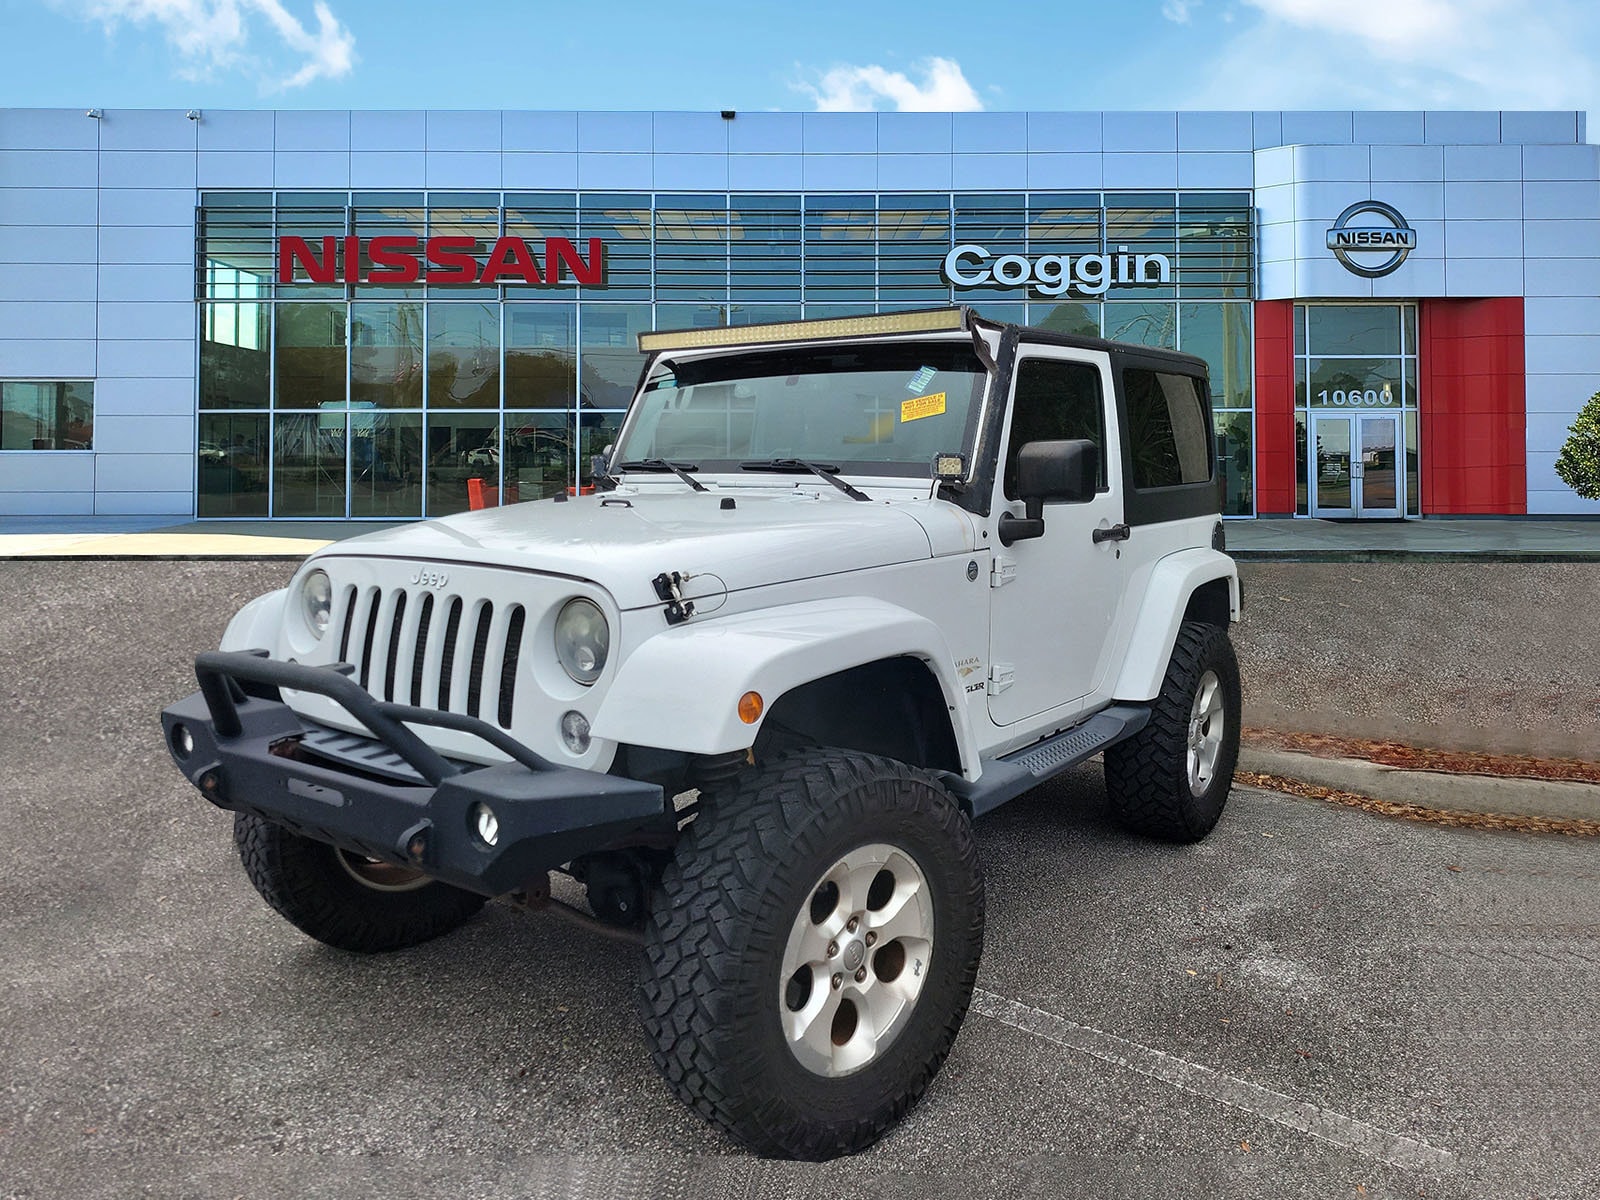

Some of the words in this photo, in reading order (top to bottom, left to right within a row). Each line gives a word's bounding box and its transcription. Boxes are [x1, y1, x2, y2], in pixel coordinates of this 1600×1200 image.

[1336, 232, 1408, 244] NISSAN
[279, 235, 602, 284] NISSAN
[945, 244, 1170, 295] Coggin
[1318, 390, 1393, 405] 10600
[410, 566, 449, 590] Jeep
